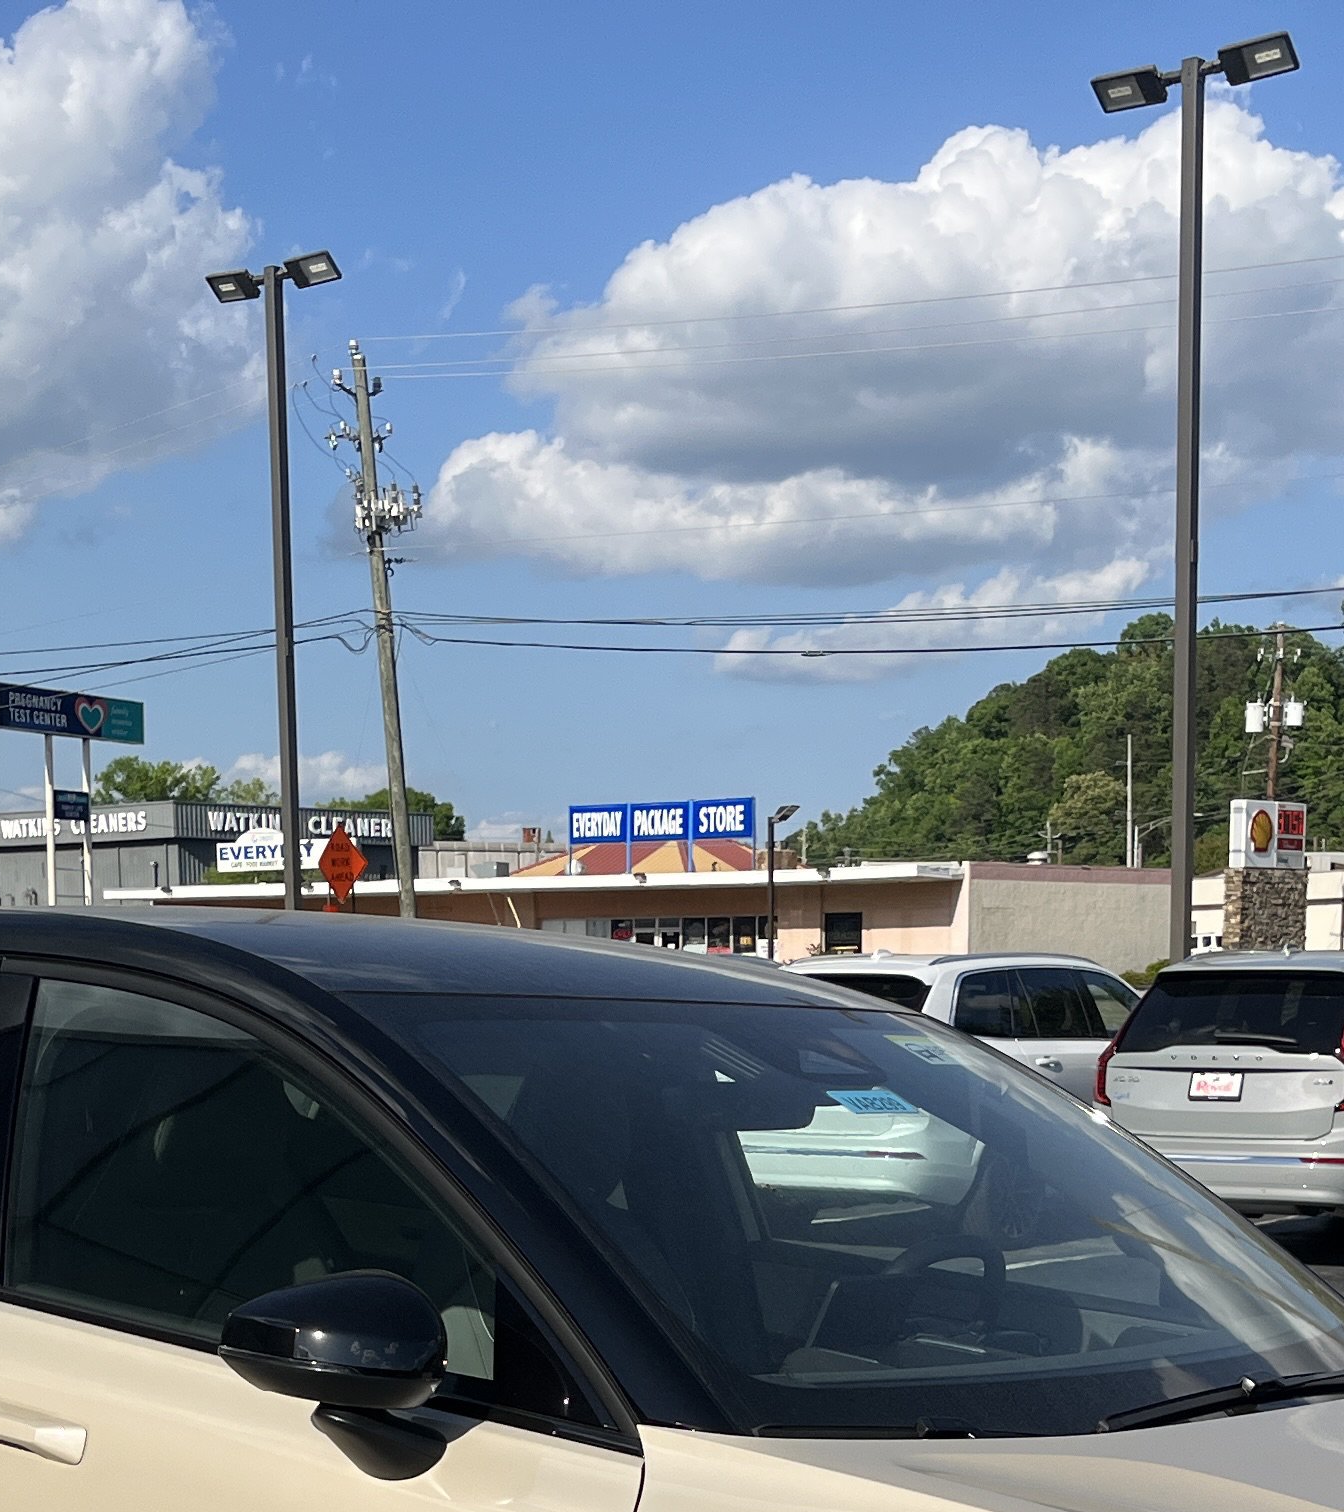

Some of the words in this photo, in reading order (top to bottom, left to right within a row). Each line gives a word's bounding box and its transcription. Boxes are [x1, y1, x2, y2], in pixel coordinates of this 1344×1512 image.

[8, 691, 62, 711] PREGNANCY
[9, 707, 31, 722] TEST
[33, 710, 68, 728] CENTER
[572, 811, 623, 838] EVERYDAY
[633, 808, 684, 836] PACKAGE
[698, 805, 745, 833] STORE
[219, 843, 314, 861] EVERYY
